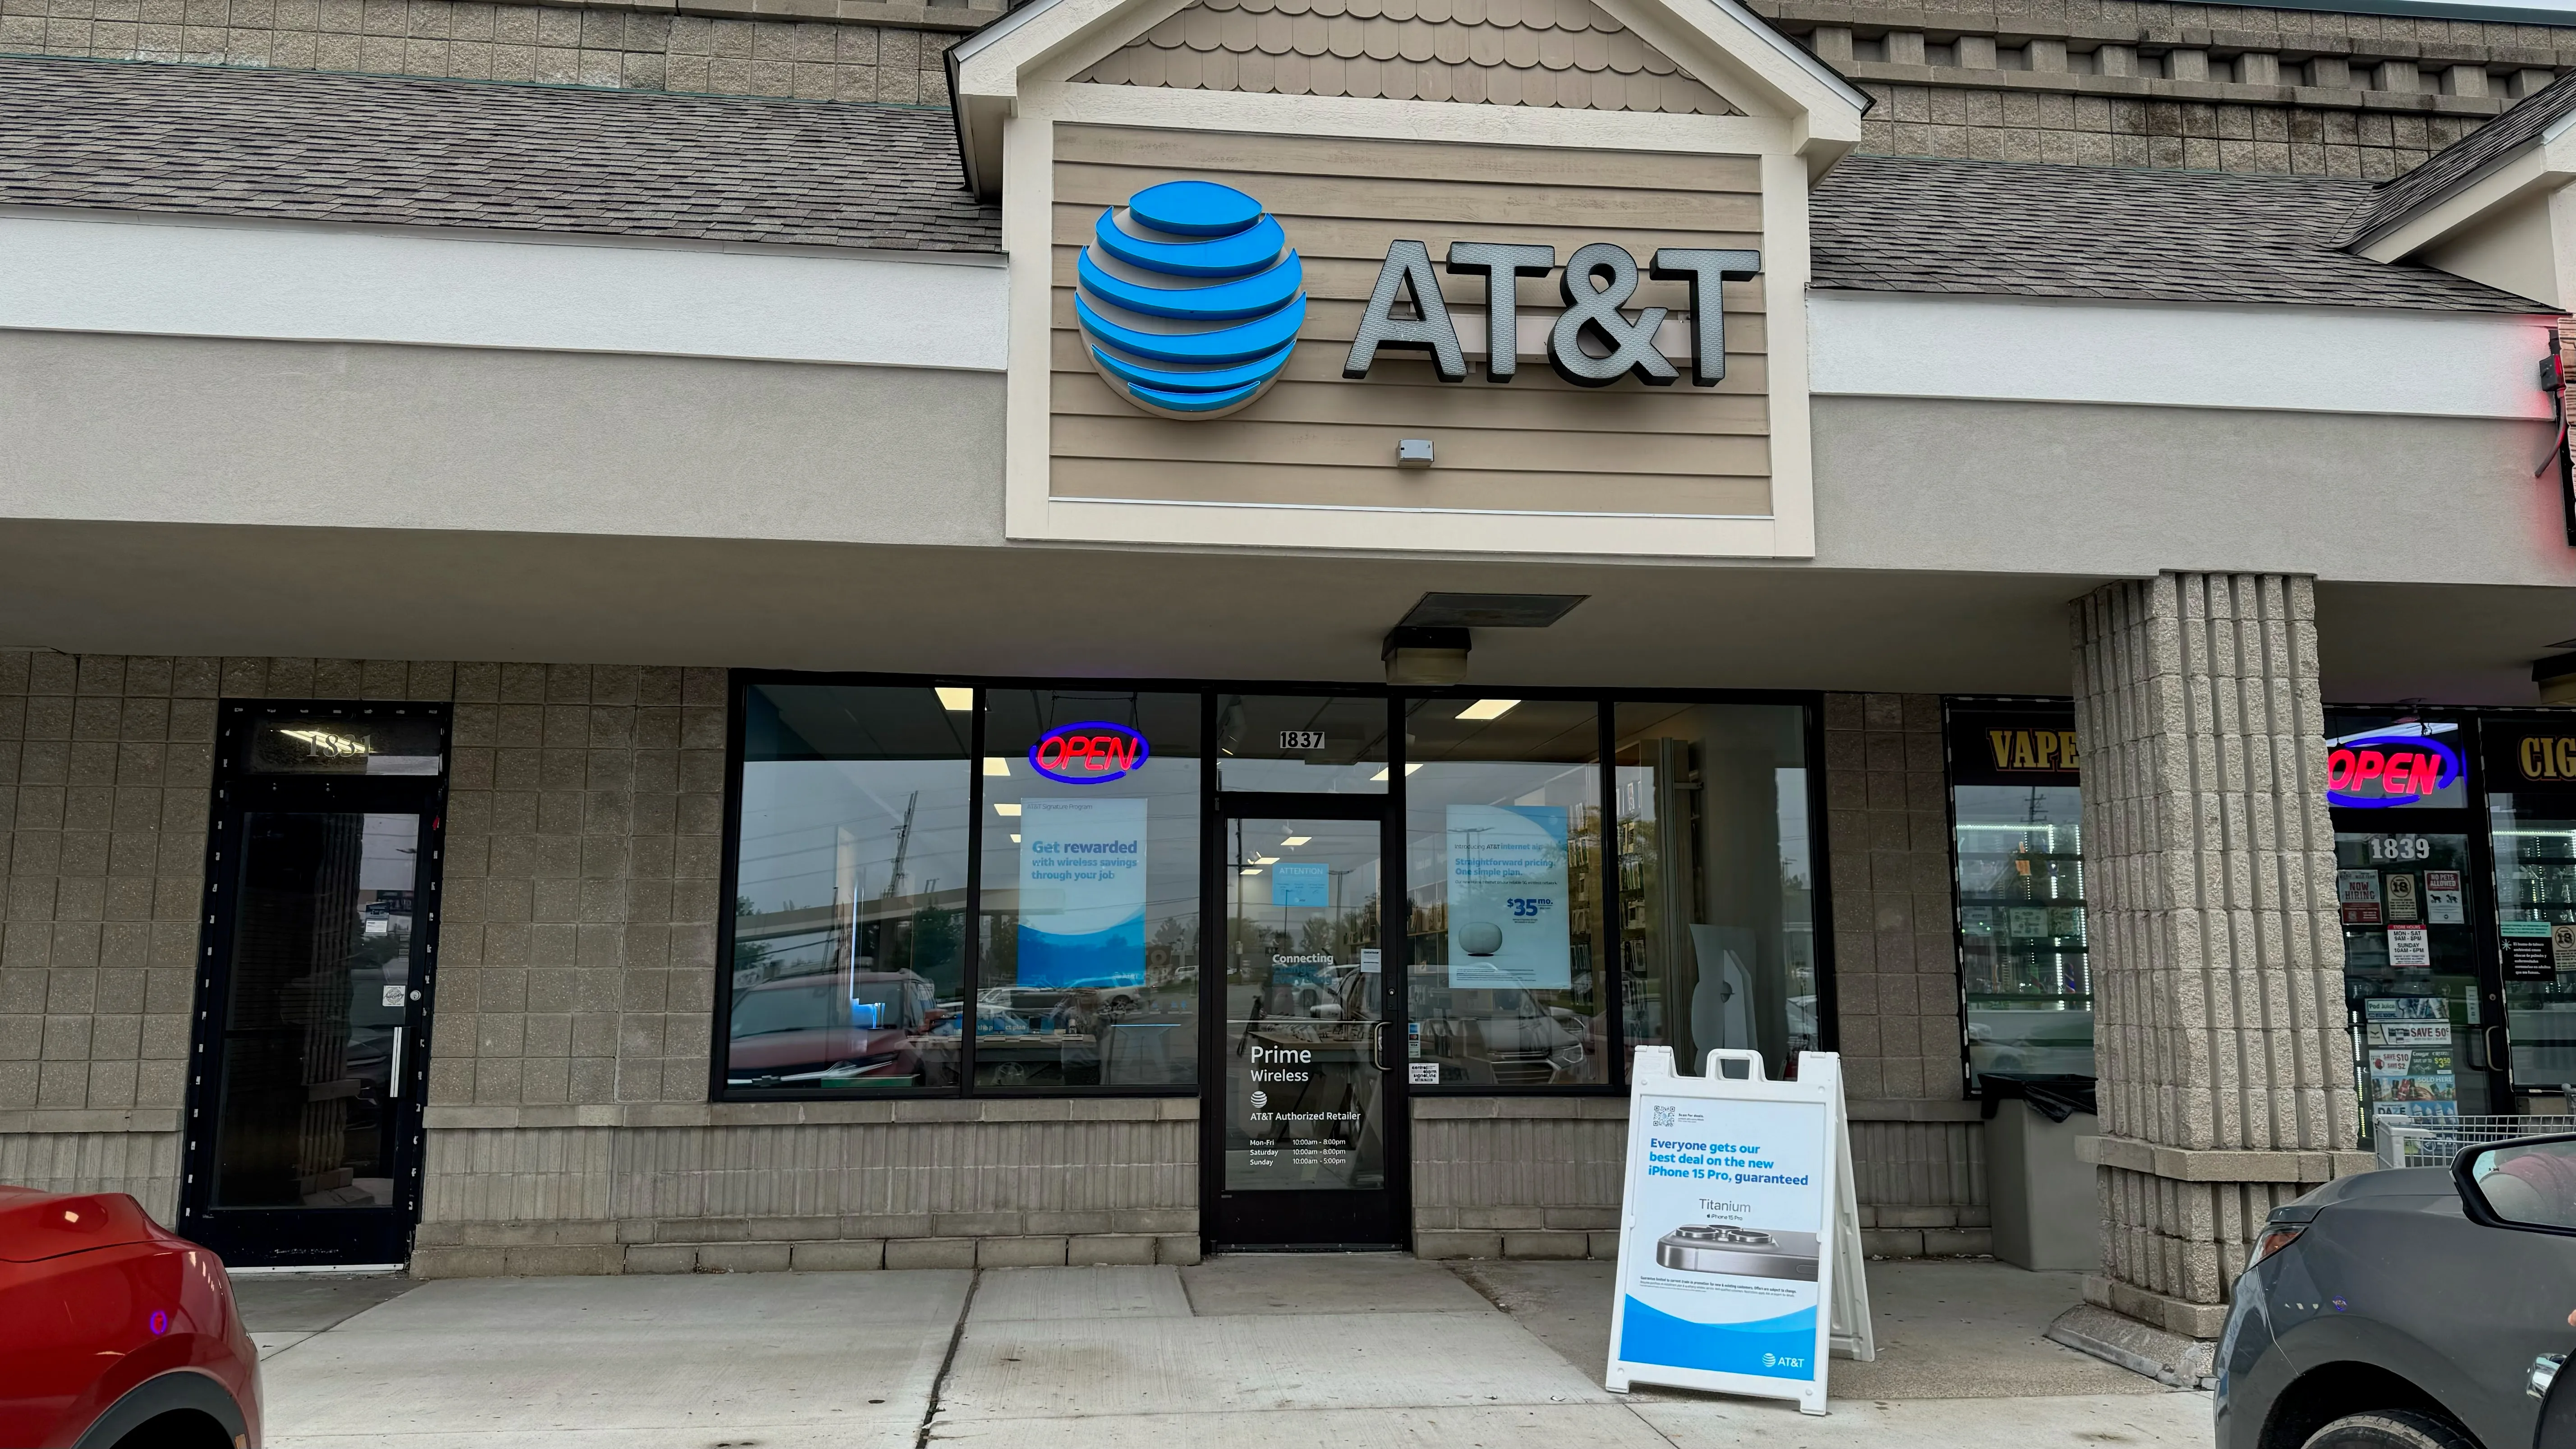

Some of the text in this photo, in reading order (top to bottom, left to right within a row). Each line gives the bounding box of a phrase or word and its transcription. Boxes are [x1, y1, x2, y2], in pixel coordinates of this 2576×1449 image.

[1342, 239, 1761, 388] AT&T
[307, 734, 371, 758] 1831
[1281, 732, 1323, 748] 1837
[1037, 736, 1138, 770] OPEN
[1989, 730, 2080, 768] VAPE
[2328, 750, 2442, 795] OPEN
[1032, 840, 1137, 854] Get rewarded
[2371, 838, 2430, 859] 1839
[1032, 858, 1137, 869] with wireless savings
[1455, 858, 1555, 869] Straightforward pricing.
[1031, 870, 1115, 881] through your job
[1474, 868, 1501, 878] simple
[1503, 869, 1523, 878] plan.
[2349, 882, 2369, 891] NOW
[2393, 881, 2408, 892] 18
[2345, 891, 2375, 900] HIRING
[1507, 898, 1538, 916] $35
[2557, 932, 2572, 944] 18
[1272, 953, 1334, 965] Connecting
[2410, 1027, 2433, 1037] SAVE
[1251, 1045, 1311, 1063] Prime
[2397, 1053, 2409, 1062] $10
[1251, 1069, 1309, 1082] Wireless
[1250, 1112, 1361, 1120] AT&T Authorized Retailer
[1651, 1138, 1760, 1154] Everyone gets our
[1649, 1151, 1774, 1168] best deal on the new
[1648, 1165, 1808, 1186] iPhone 15 Pro, guaranteed
[1699, 1198, 1751, 1213] Titanium
[1777, 1357, 1805, 1367] AT&T
